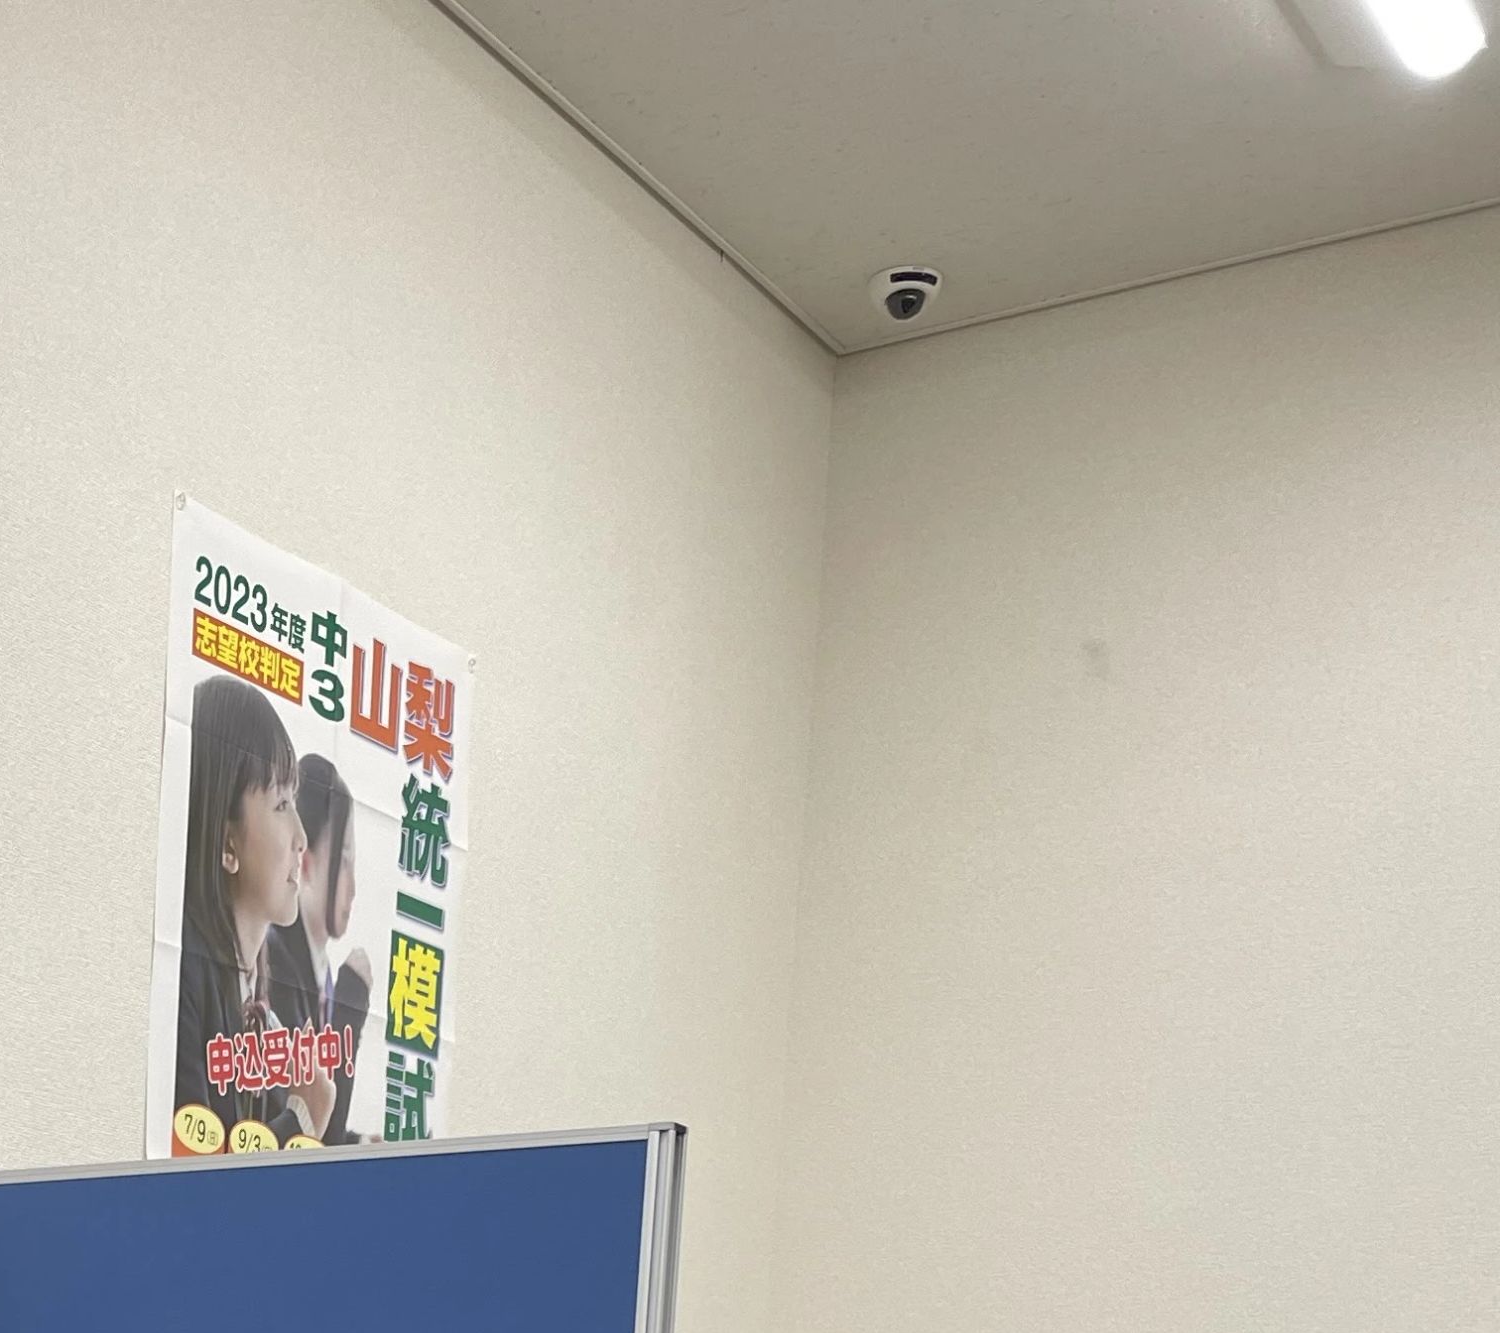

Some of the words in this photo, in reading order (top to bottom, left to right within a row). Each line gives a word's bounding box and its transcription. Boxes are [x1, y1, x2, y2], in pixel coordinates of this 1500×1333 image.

[195, 615, 301, 699] 志望校判定
